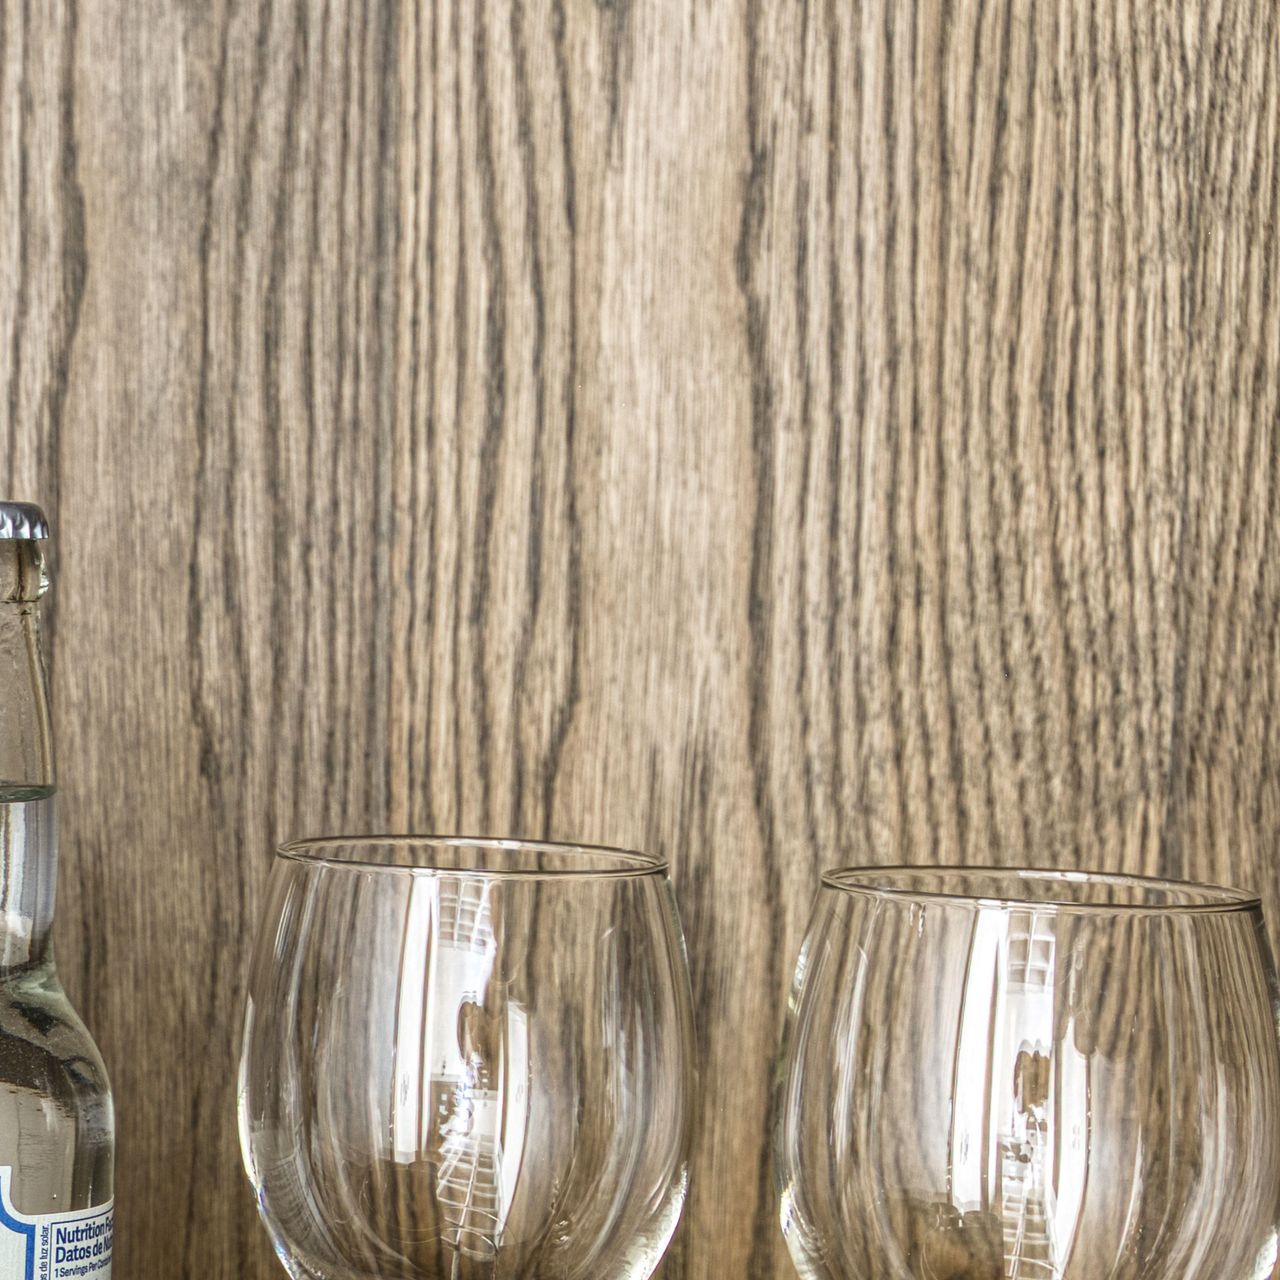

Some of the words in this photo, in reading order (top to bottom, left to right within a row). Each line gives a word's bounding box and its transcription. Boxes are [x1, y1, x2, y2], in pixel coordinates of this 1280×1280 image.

[56, 1221, 104, 1244] Nutrition
[40, 1247, 48, 1260] luz
[55, 1244, 91, 1263] Datos
[93, 1239, 102, 1256] de
[39, 1261, 48, 1272] de
[60, 1262, 88, 1277] Servings
